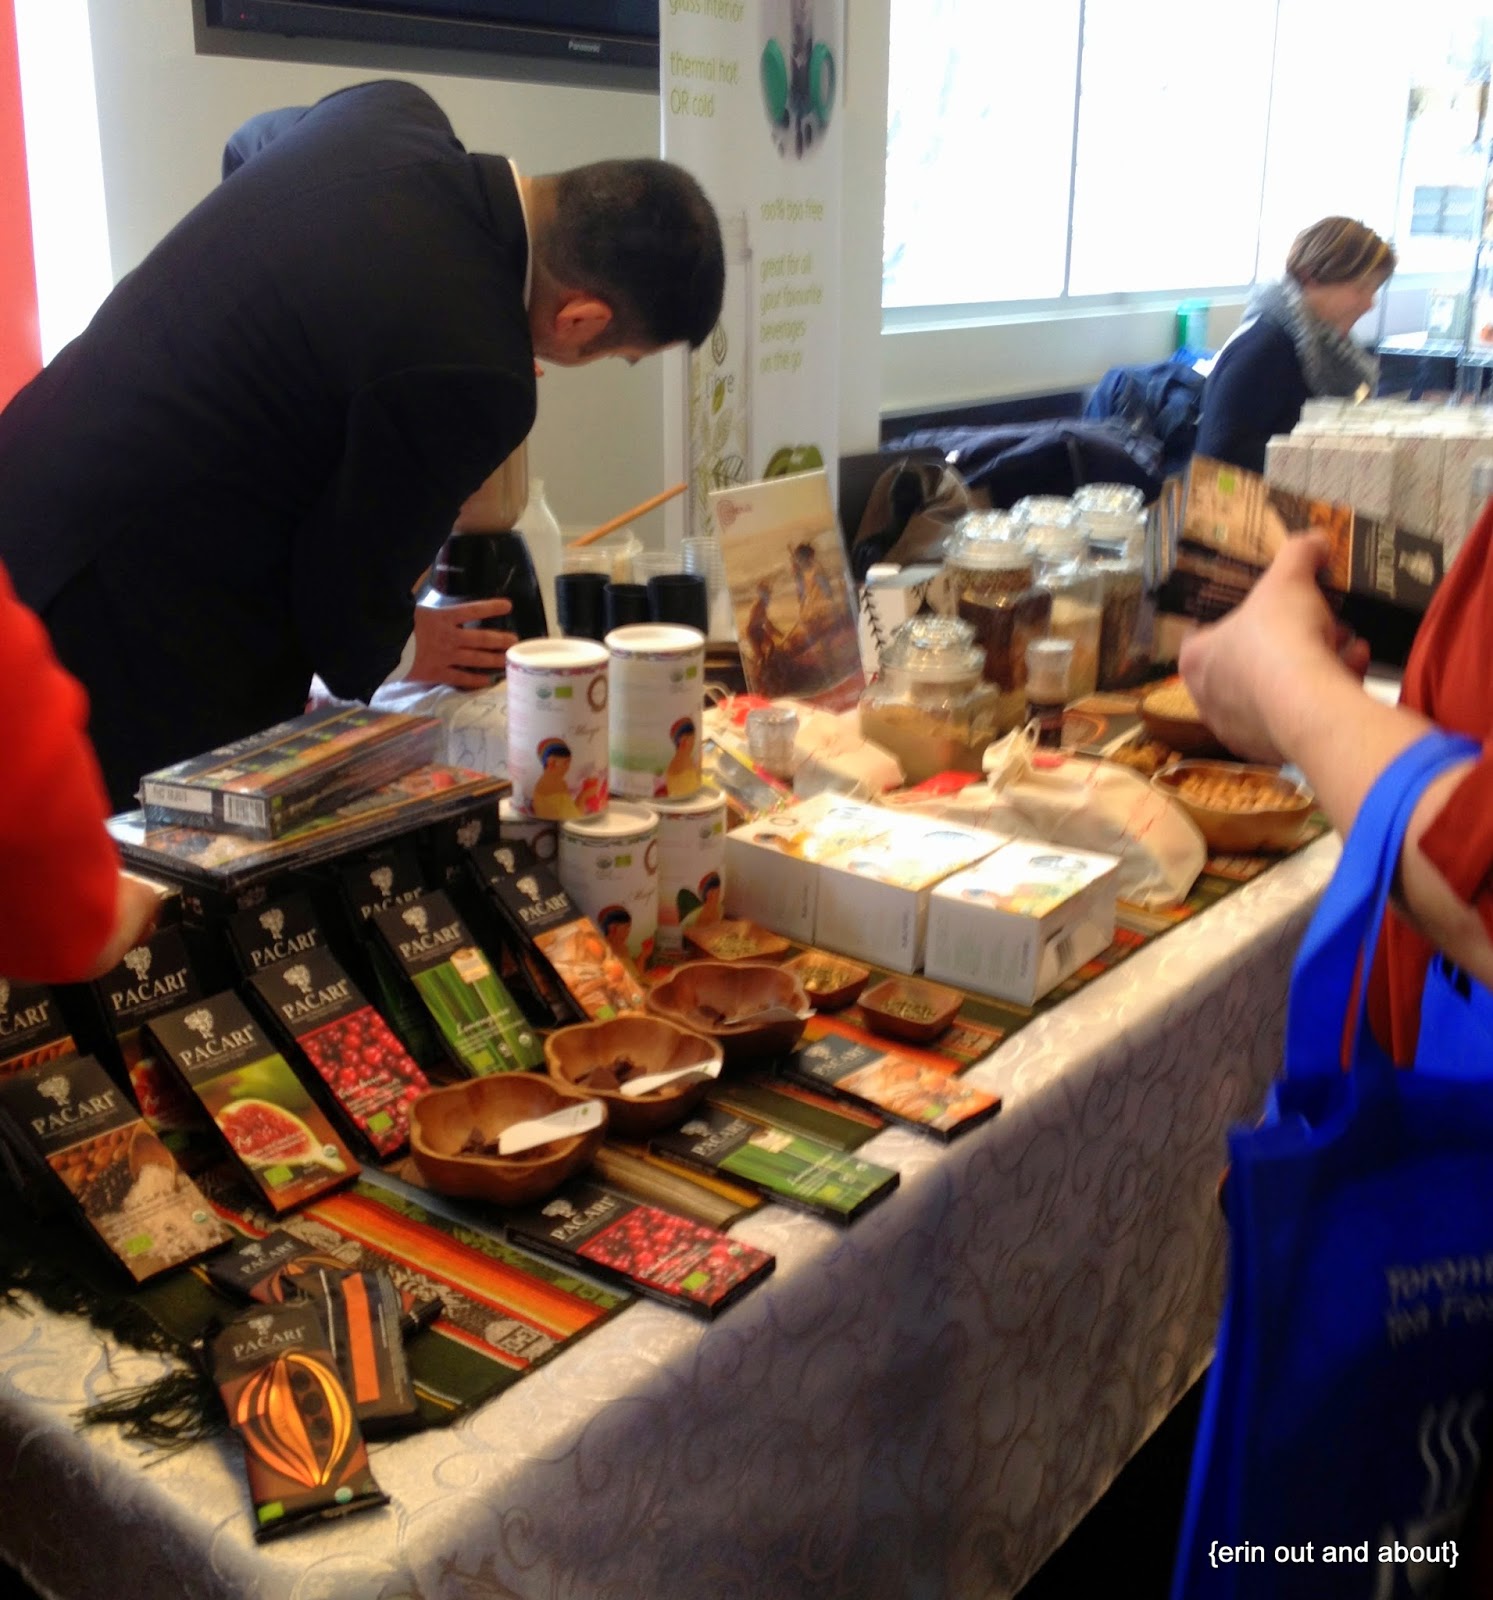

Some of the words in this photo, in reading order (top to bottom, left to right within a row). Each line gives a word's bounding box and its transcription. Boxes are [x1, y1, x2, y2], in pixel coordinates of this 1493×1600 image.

[670, 52, 716, 81] thermal
[719, 60, 739, 85] hot
[671, 89, 690, 115] OR
[693, 94, 714, 117] cold
[250, 928, 317, 967] PACARI
[399, 921, 460, 958] PACARI
[111, 968, 187, 1010] PACARI
[281, 979, 349, 1019] PACARI
[179, 1025, 255, 1066] PACARI
[31, 1090, 115, 1135] PACARI
[550, 1195, 616, 1240] PACARI
[233, 1326, 306, 1357] PACARI
